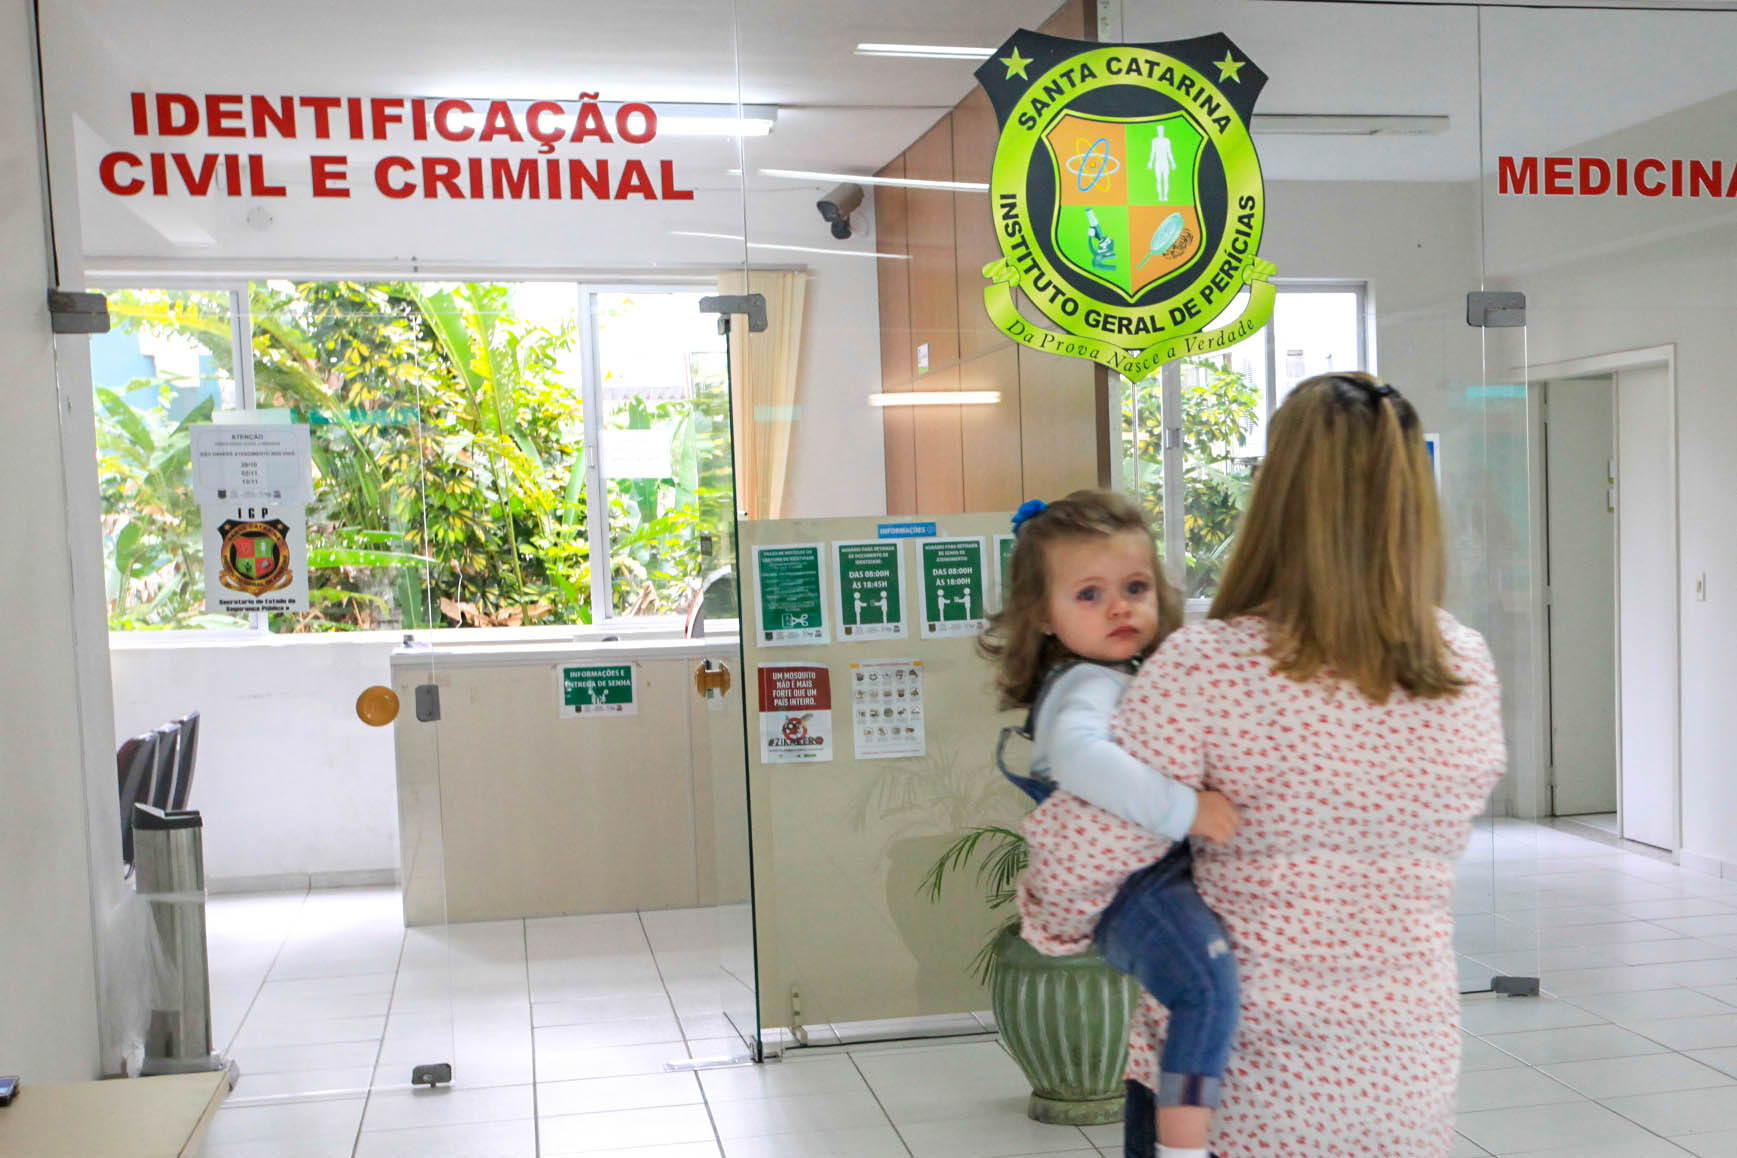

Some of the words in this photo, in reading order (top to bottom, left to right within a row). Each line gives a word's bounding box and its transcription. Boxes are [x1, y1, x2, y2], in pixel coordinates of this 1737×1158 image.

[1017, 62, 1097, 132] SANTA
[1106, 56, 1233, 135] CATARINA
[130, 91, 658, 154] IDENTIFICAÇÃO
[99, 152, 287, 198] CIVIL
[311, 155, 351, 198] E
[374, 156, 695, 200] CRIMINAL
[1498, 156, 1737, 198] MEDICIN
[999, 193, 1080, 317] INSTITUTO
[1084, 309, 1165, 335] GERAL
[1169, 297, 1202, 327] DE
[1199, 194, 1256, 305] PERÍCIAS
[1006, 319, 1034, 344] Da
[1039, 335, 1102, 360] Prova
[1107, 351, 1160, 374] Nasce
[1166, 346, 1176, 359] a
[1184, 318, 1255, 353] Verdade
[880, 526, 926, 536] INFORMAÇÕES
[848, 570, 864, 578] DAS
[864, 569, 890, 578] 08:00H
[932, 568, 947, 576] DAS
[948, 567, 973, 575] 08:00H
[863, 580, 888, 589] 18:45H
[947, 577, 971, 586] 18:00H
[570, 669, 619, 678] INFORMAÇÕES
[620, 669, 625, 677] E
[772, 672, 783, 680] UM
[783, 671, 816, 680] MOSQUITO
[608, 679, 632, 687] SENHA
[776, 680, 790, 688] NÃO
[796, 680, 813, 688] MAIS
[772, 689, 792, 697] FORTE
[793, 689, 806, 697] QUE
[806, 688, 817, 696] UM
[789, 697, 816, 706] INTEIRO.
